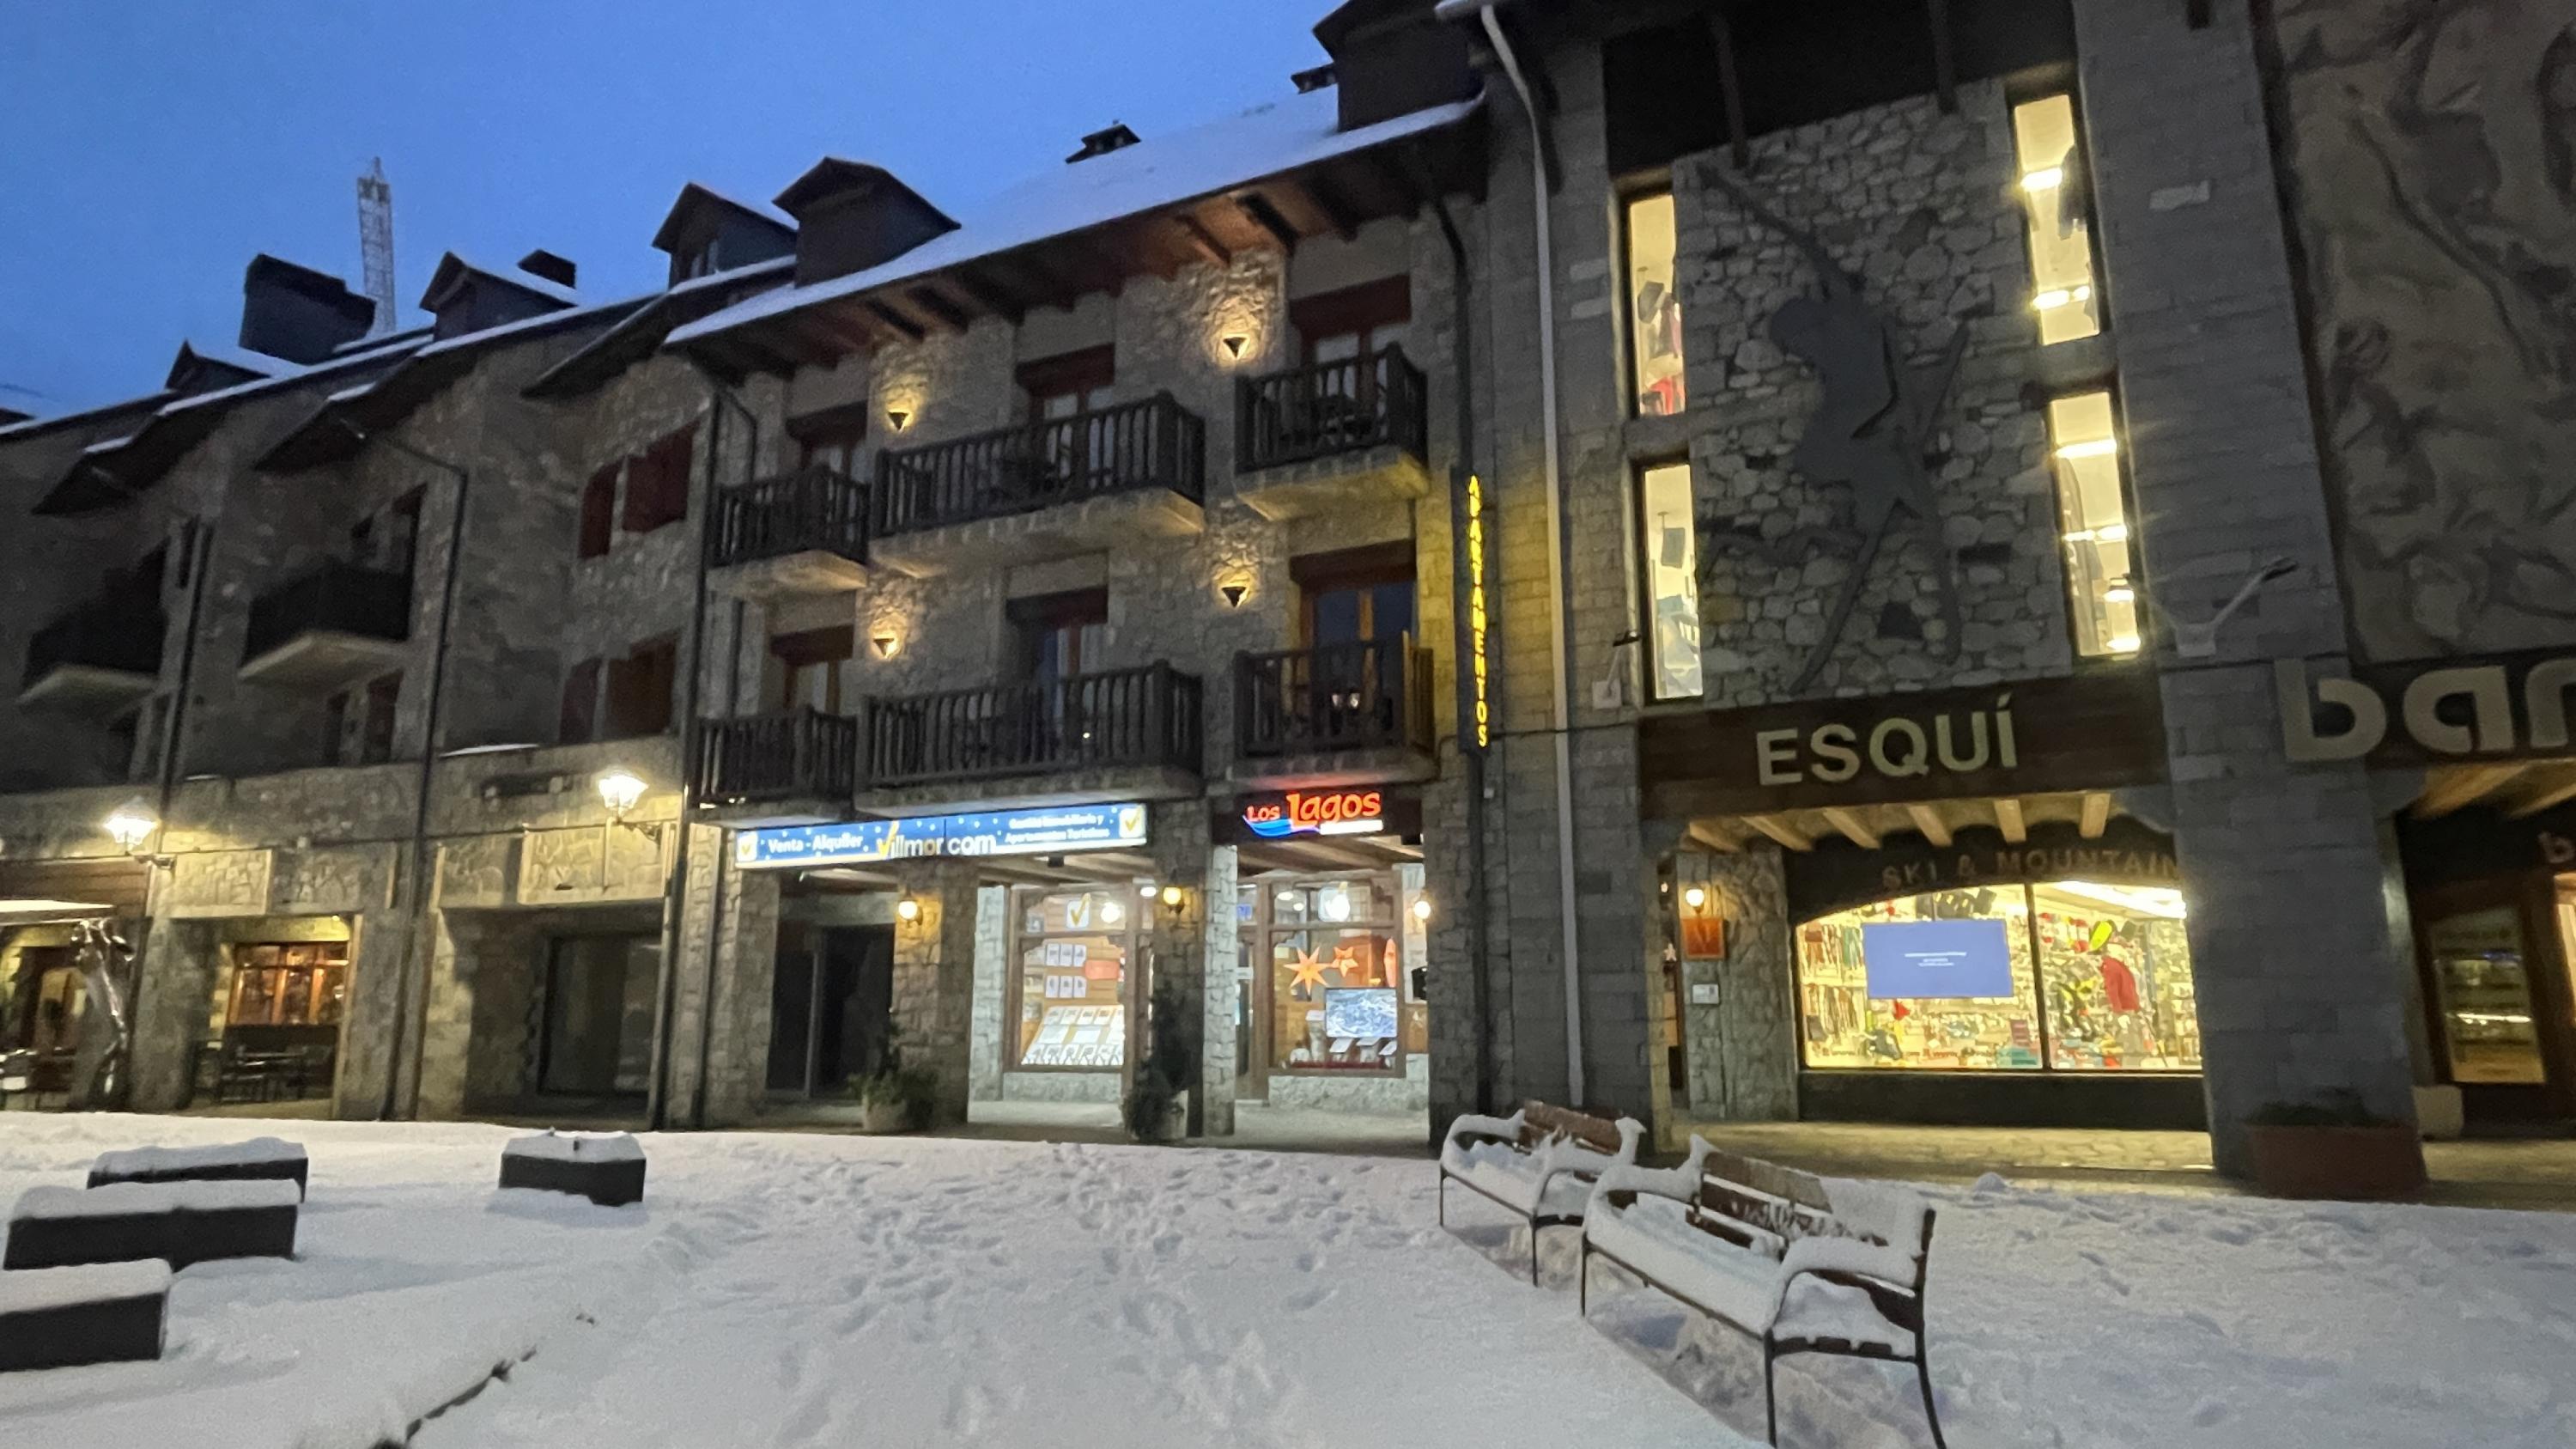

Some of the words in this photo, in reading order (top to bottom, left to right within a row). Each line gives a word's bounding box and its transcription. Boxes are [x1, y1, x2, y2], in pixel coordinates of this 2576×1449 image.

[1468, 474, 1487, 748] APARTAMENTOS
[1756, 691, 2017, 786] ESQUÍ
[1285, 791, 1382, 827] Lagos
[768, 838, 805, 853] Venta
[812, 831, 864, 853] Alquiler
[1881, 861, 1938, 889] SKI
[1958, 854, 1978, 877] &
